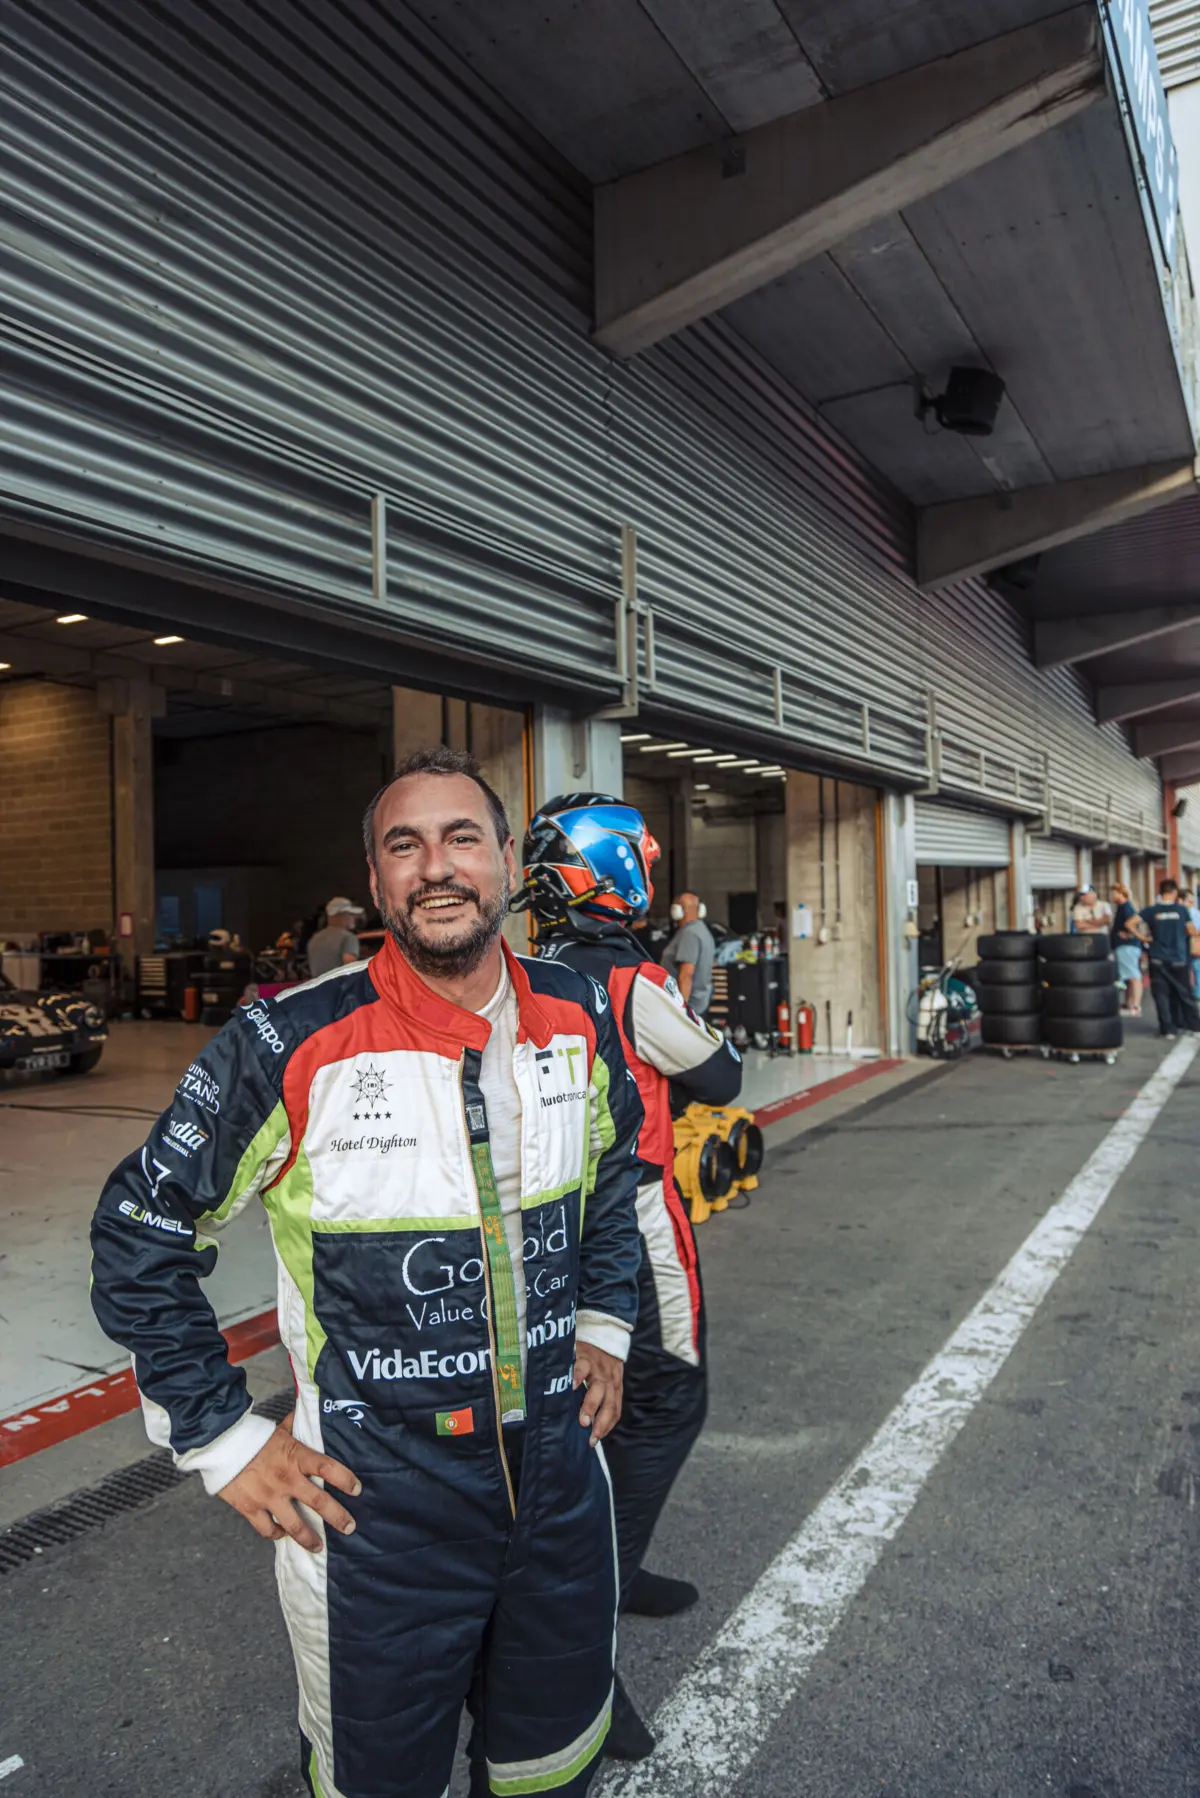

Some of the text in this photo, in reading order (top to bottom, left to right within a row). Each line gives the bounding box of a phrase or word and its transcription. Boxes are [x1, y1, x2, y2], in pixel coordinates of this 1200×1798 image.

[330, 1134, 417, 1154] Hotel Dighton
[119, 1200, 193, 1235] EUMEL
[405, 1298, 474, 1331] Value
